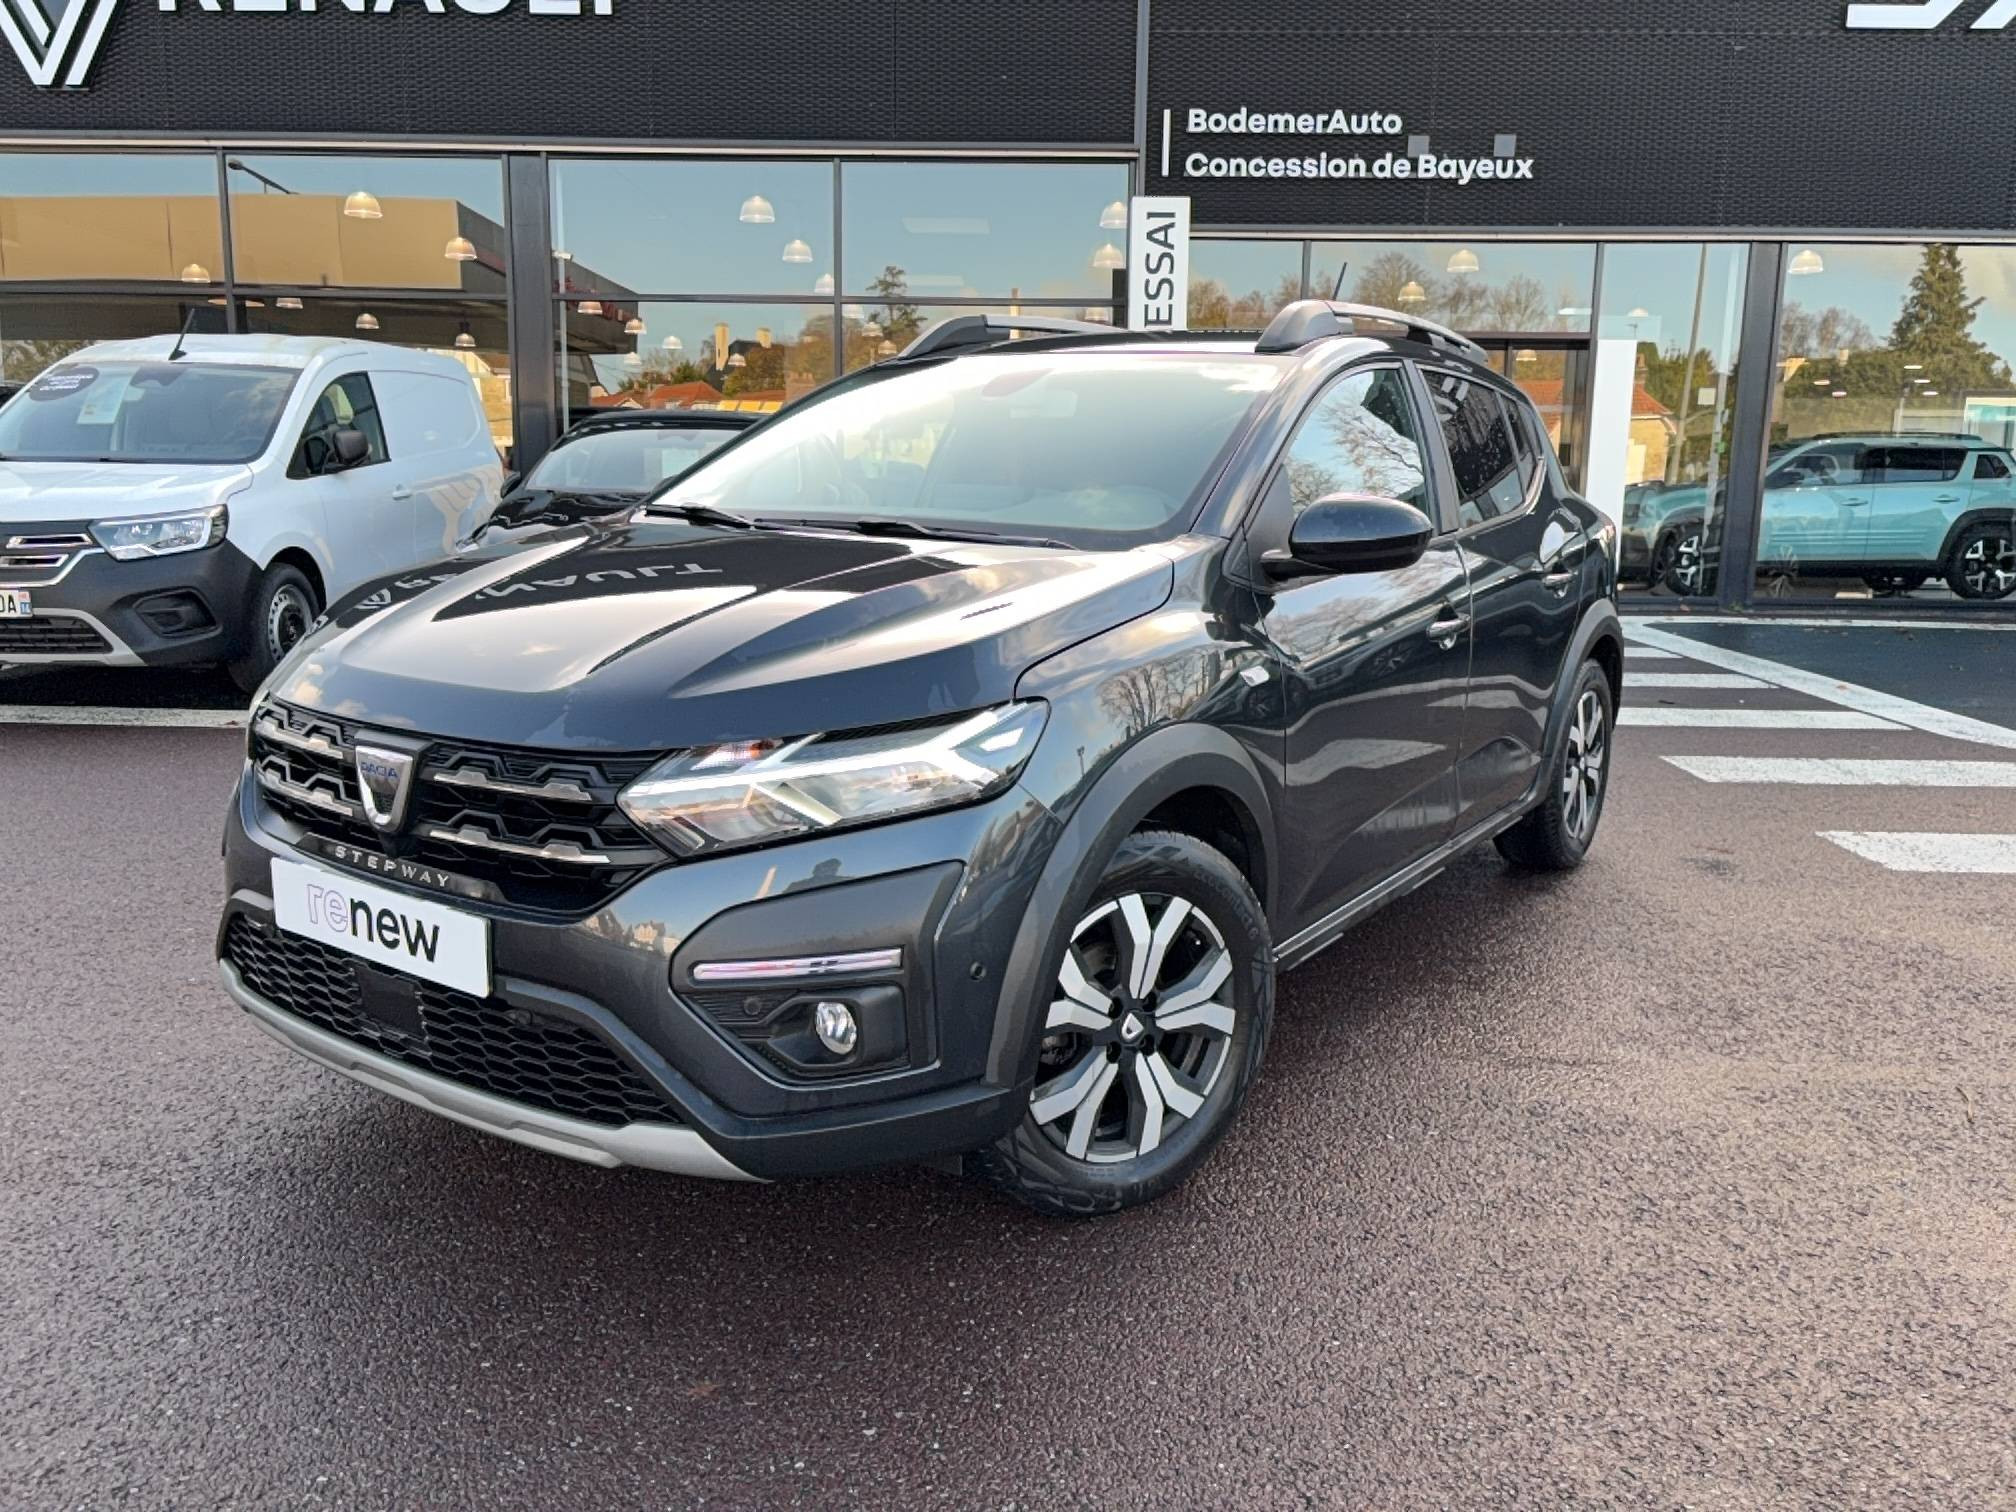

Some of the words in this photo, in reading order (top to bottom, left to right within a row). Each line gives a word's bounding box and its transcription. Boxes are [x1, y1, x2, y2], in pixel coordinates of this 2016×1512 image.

[1187, 107, 1402, 133] BodemerAuto
[1184, 152, 1367, 178] Concession
[1372, 152, 1411, 178] de
[1418, 153, 1534, 184] Bayeux
[1144, 211, 1176, 328] ESSAI
[334, 845, 449, 887] STEPWAY
[306, 883, 440, 963] renew
